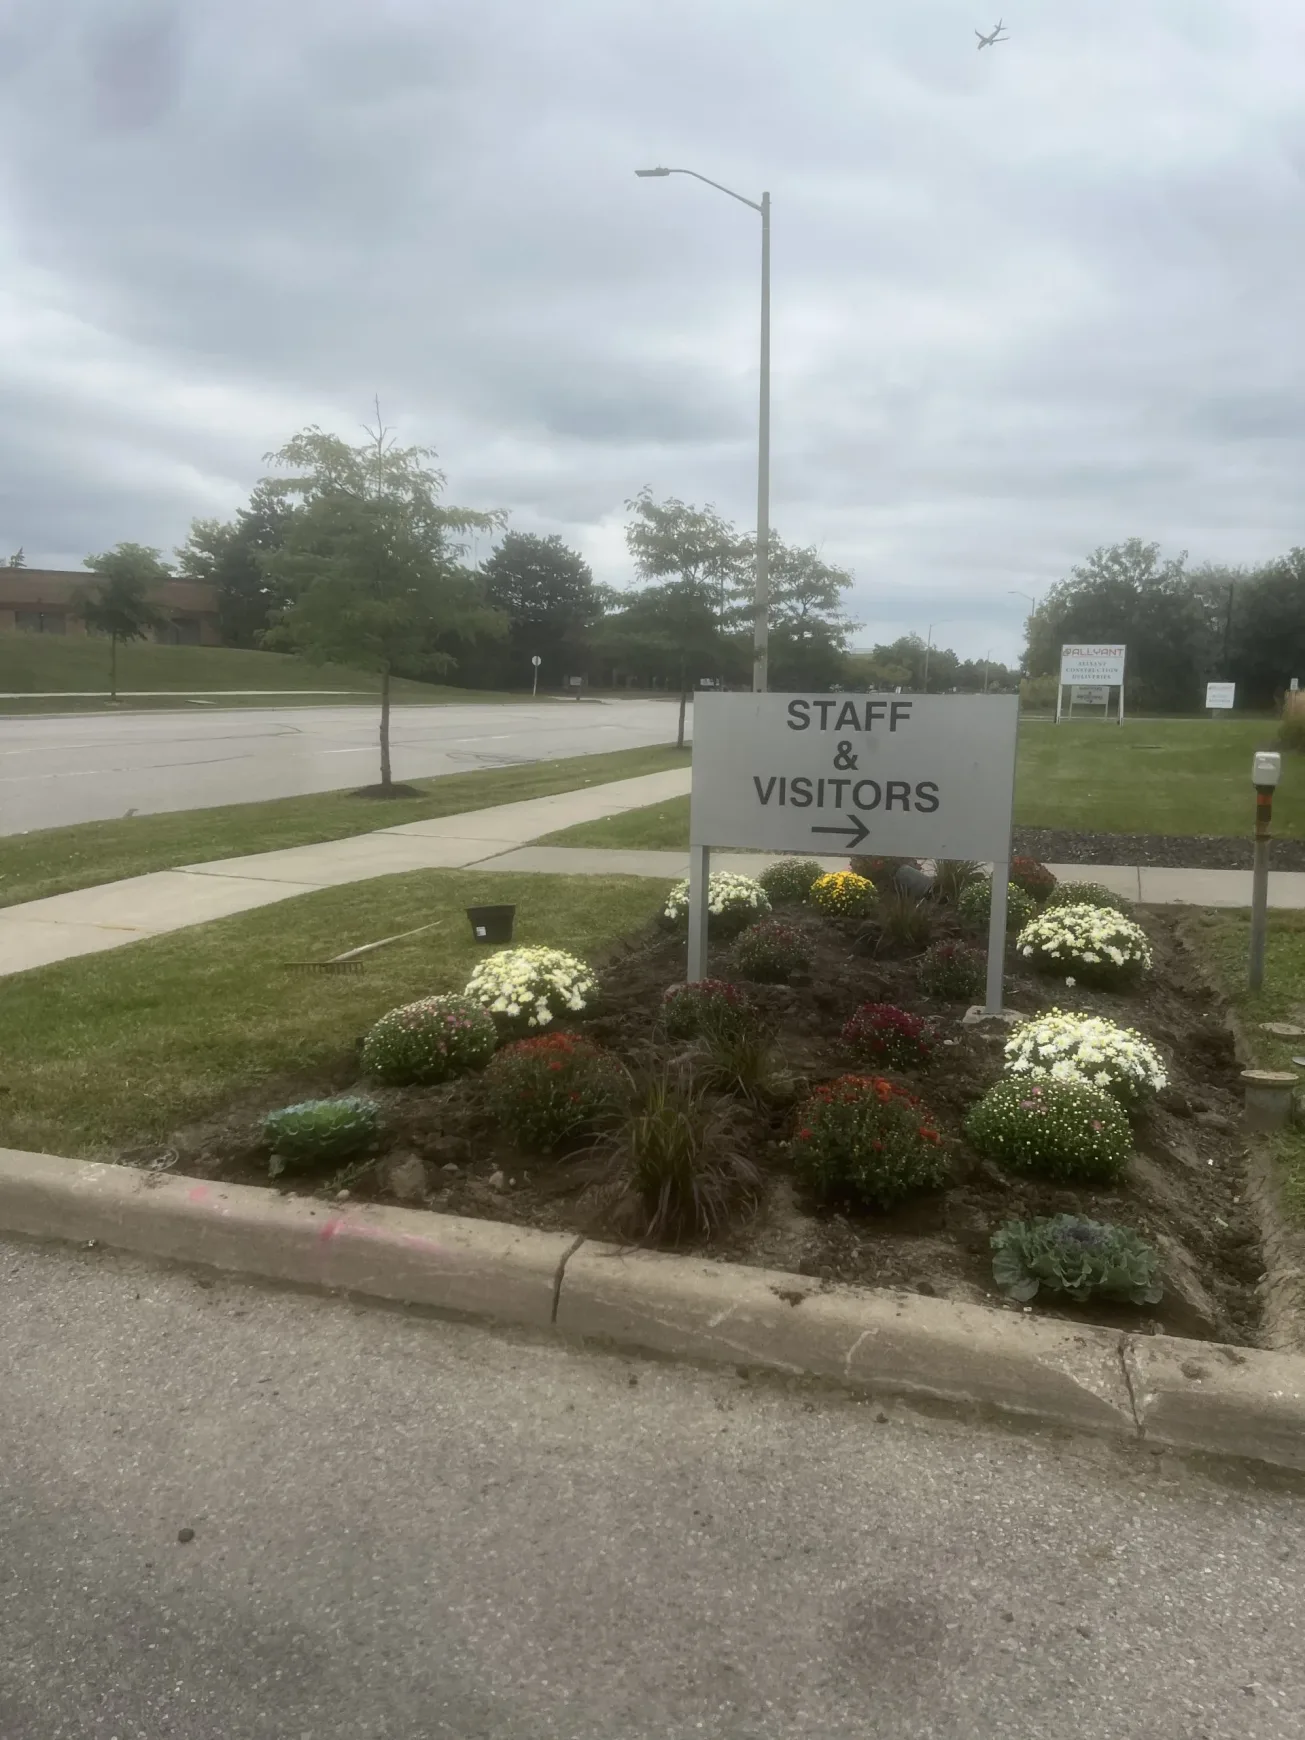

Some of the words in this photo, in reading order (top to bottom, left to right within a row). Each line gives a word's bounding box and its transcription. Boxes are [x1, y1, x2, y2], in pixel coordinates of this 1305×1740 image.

[1072, 648, 1124, 656] ALLYANT
[787, 699, 912, 732] STAFF
[833, 740, 859, 771] &
[753, 776, 940, 813] VISITORS
